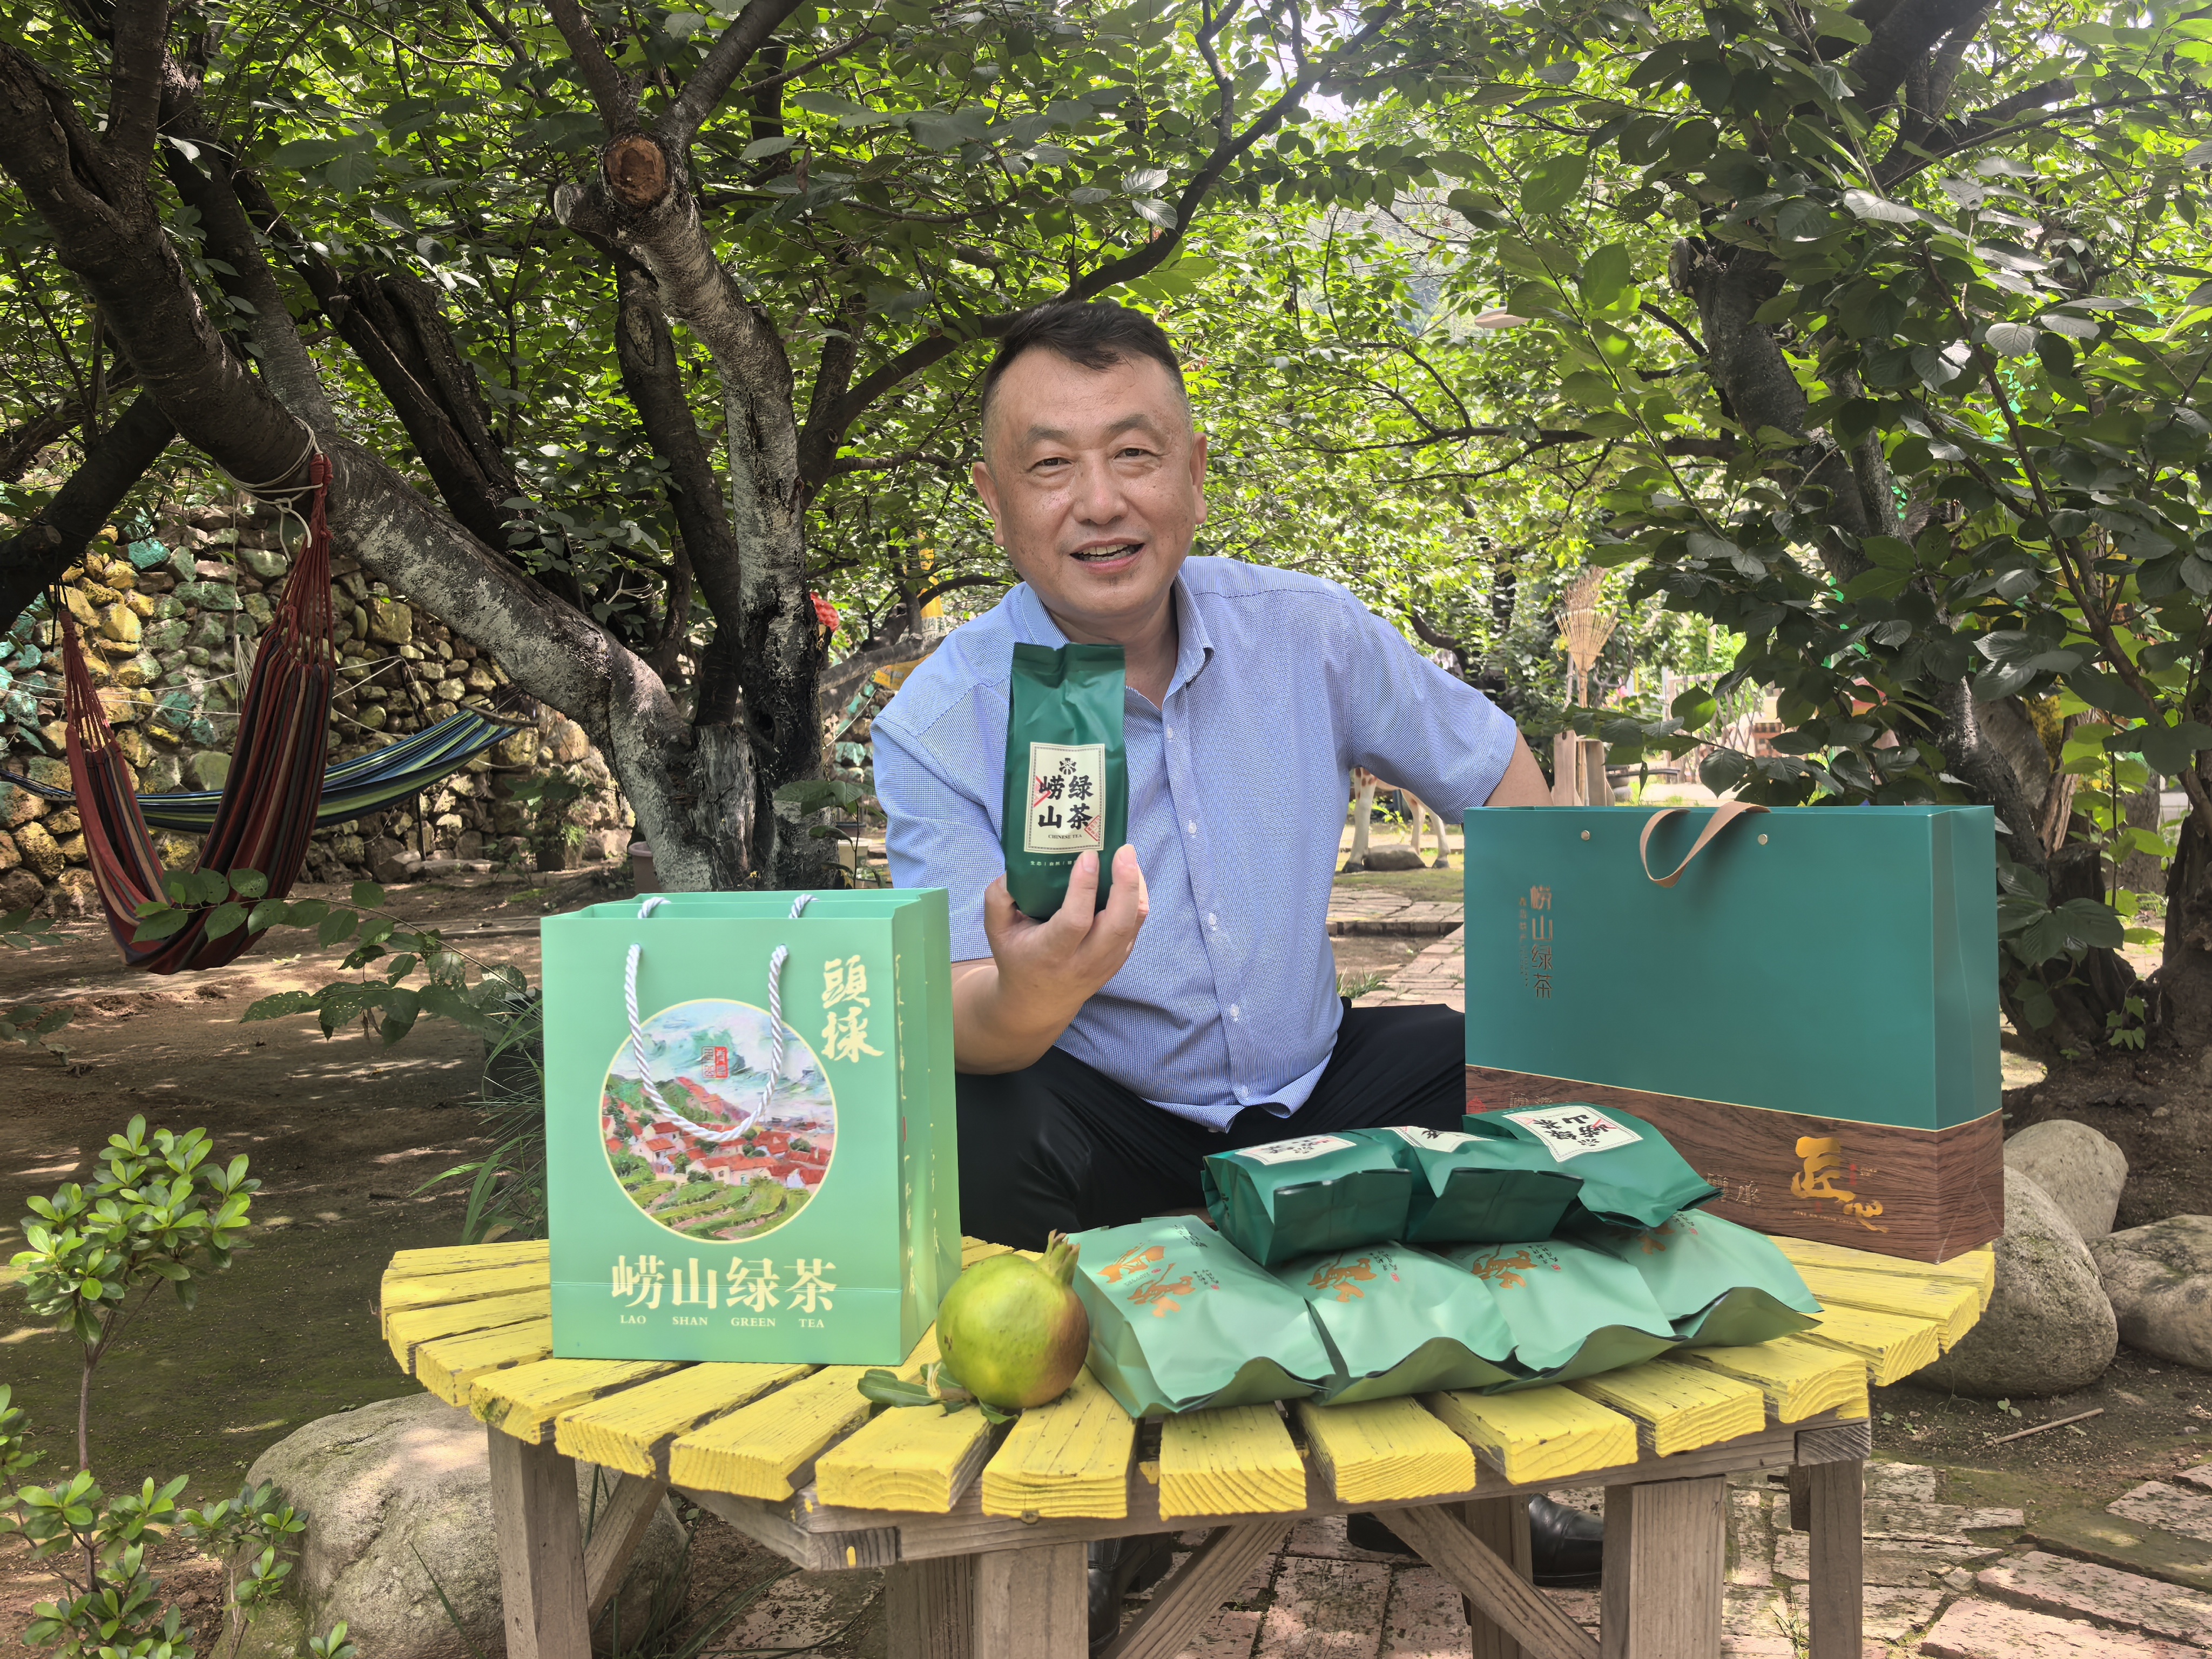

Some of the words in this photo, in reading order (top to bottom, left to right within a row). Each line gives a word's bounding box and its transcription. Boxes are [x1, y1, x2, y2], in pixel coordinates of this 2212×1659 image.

[1038, 774, 1065, 828] 崂山
[1067, 775, 1094, 830] 绿茶
[1530, 885, 1553, 999] 崂山绿茶
[611, 1255, 837, 1313] 崂山绿茶
[620, 1314, 646, 1324] LAO
[672, 1316, 708, 1326] SHAN
[731, 1317, 776, 1327] GREEN
[798, 1318, 825, 1328] TEA
